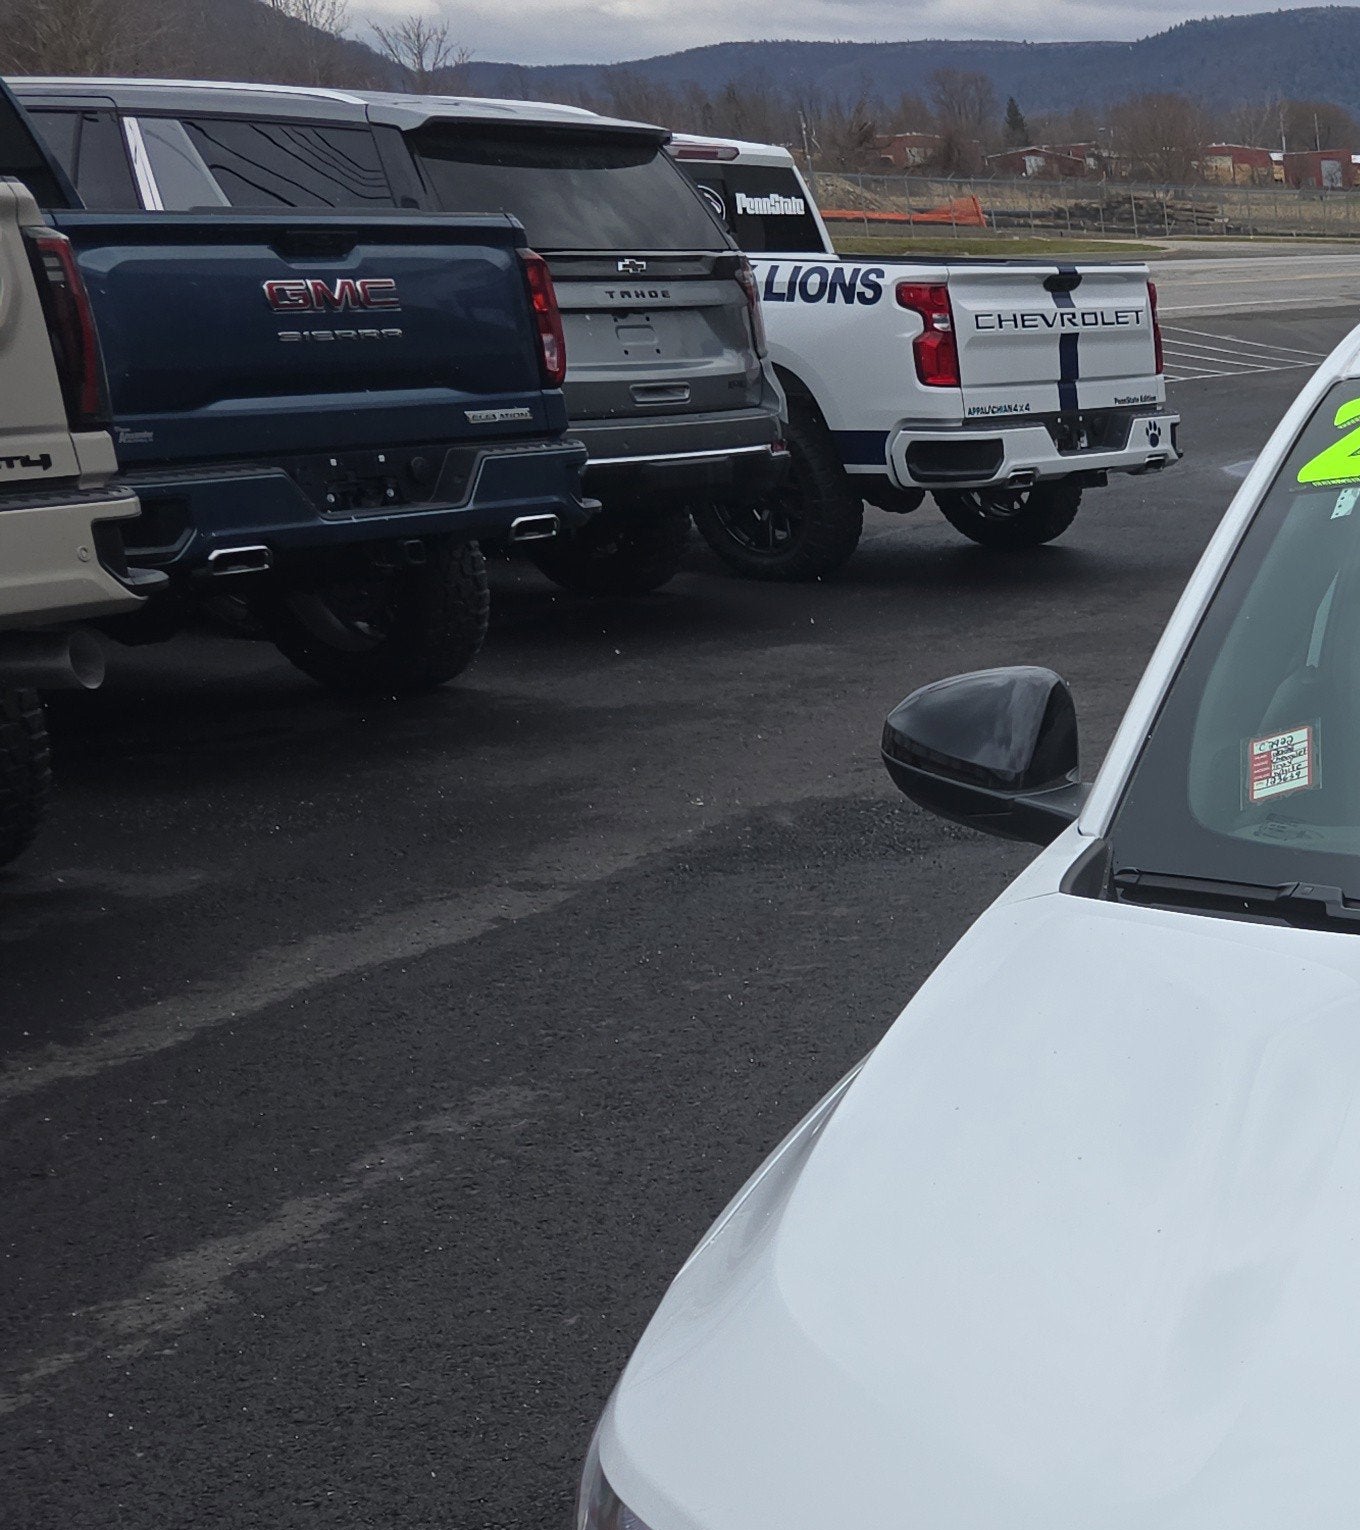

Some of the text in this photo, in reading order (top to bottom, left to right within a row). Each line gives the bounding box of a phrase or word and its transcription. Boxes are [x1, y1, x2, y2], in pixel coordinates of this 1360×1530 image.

[263, 278, 400, 312] GMC
[605, 290, 671, 299] TAHOE
[763, 265, 885, 306] LIONS
[974, 309, 1144, 330] CHEVROLET
[278, 328, 403, 342] SIERRA
